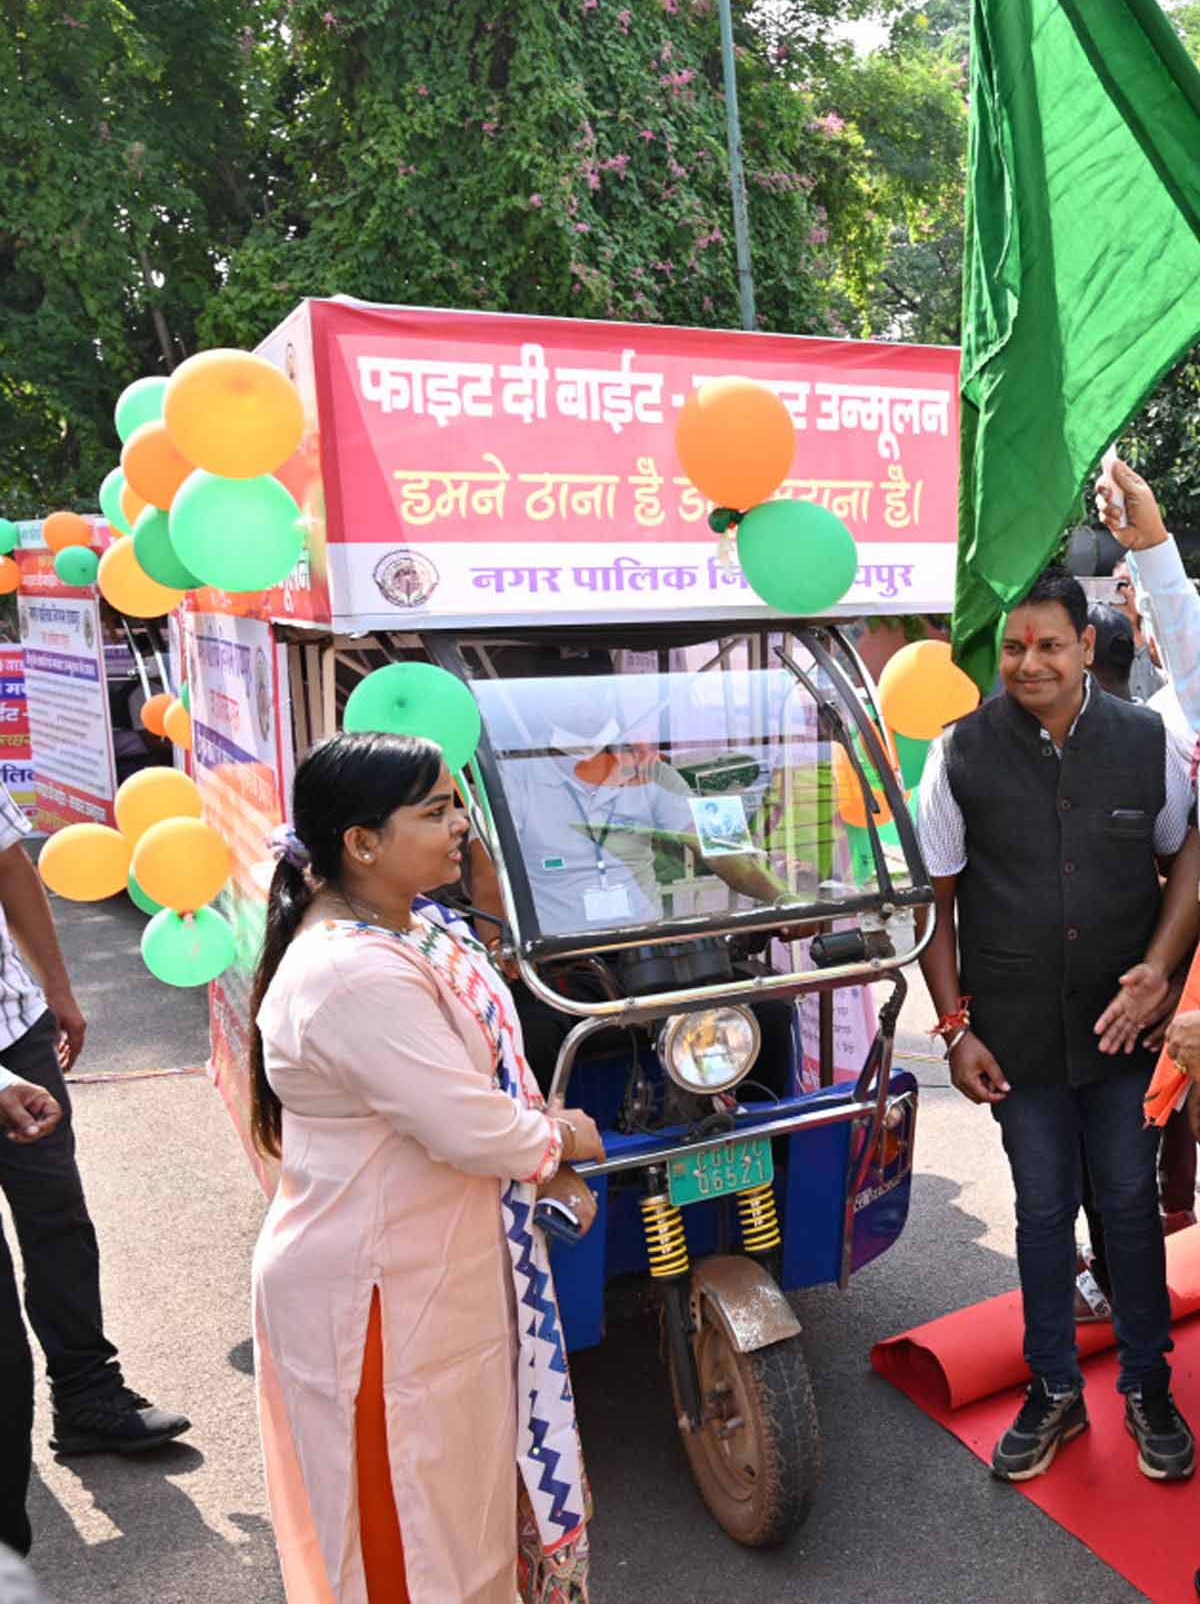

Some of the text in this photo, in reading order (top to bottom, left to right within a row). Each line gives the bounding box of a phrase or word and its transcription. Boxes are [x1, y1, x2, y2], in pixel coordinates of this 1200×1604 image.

[358, 353, 494, 428] फाइट
[501, 344, 549, 424] दी
[555, 348, 664, 434] बाईट
[814, 381, 951, 462] उन्मूलन
[394, 452, 507, 527] हमने
[518, 473, 619, 521] ठाना
[628, 456, 665, 528] है
[470, 565, 558, 594] नगर
[572, 556, 697, 593] पालिक
